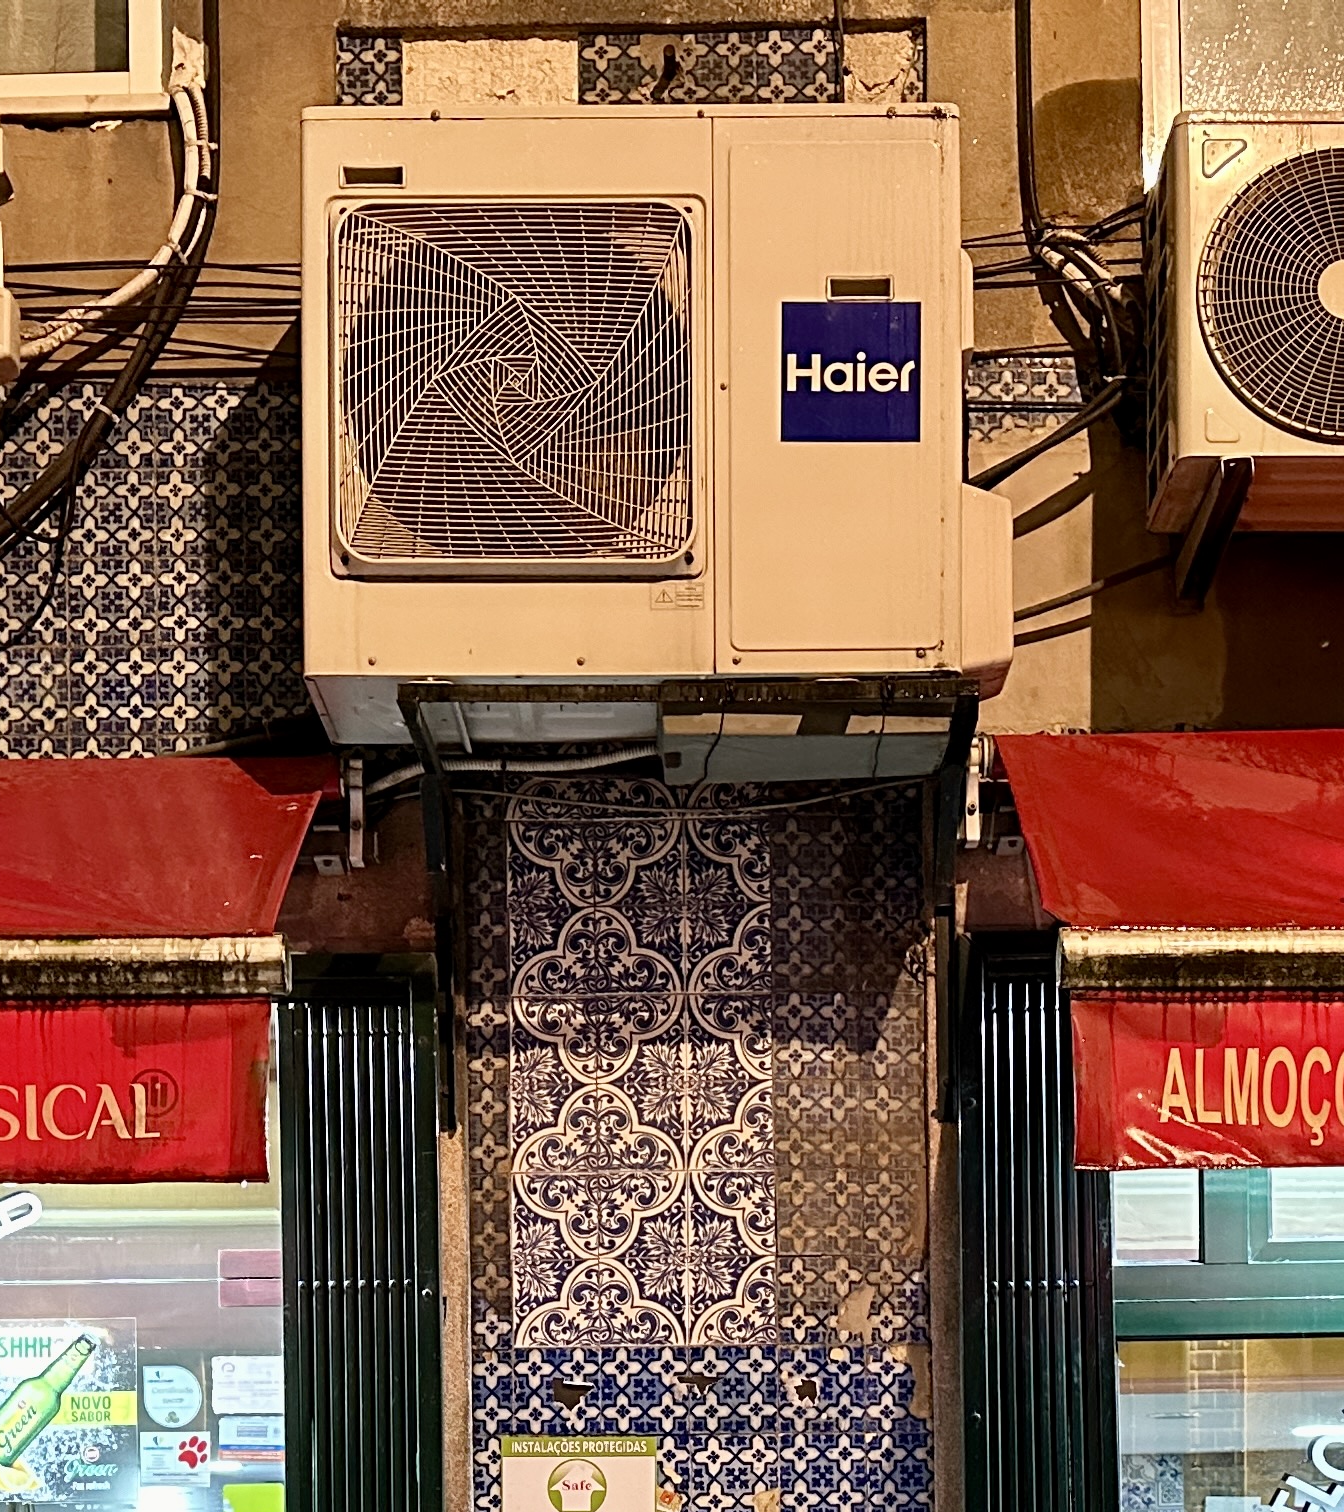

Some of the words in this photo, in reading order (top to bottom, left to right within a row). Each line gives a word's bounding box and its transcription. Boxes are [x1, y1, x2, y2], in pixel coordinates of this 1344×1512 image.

[786, 351, 916, 393] Haier
[70, 1395, 112, 1410] NOVO
[71, 1410, 111, 1422] SABOR
[511, 1438, 580, 1456] INSTALAÇÕES
[582, 1440, 647, 1453] PROTEGIDAS
[561, 1480, 592, 1491] Safe
